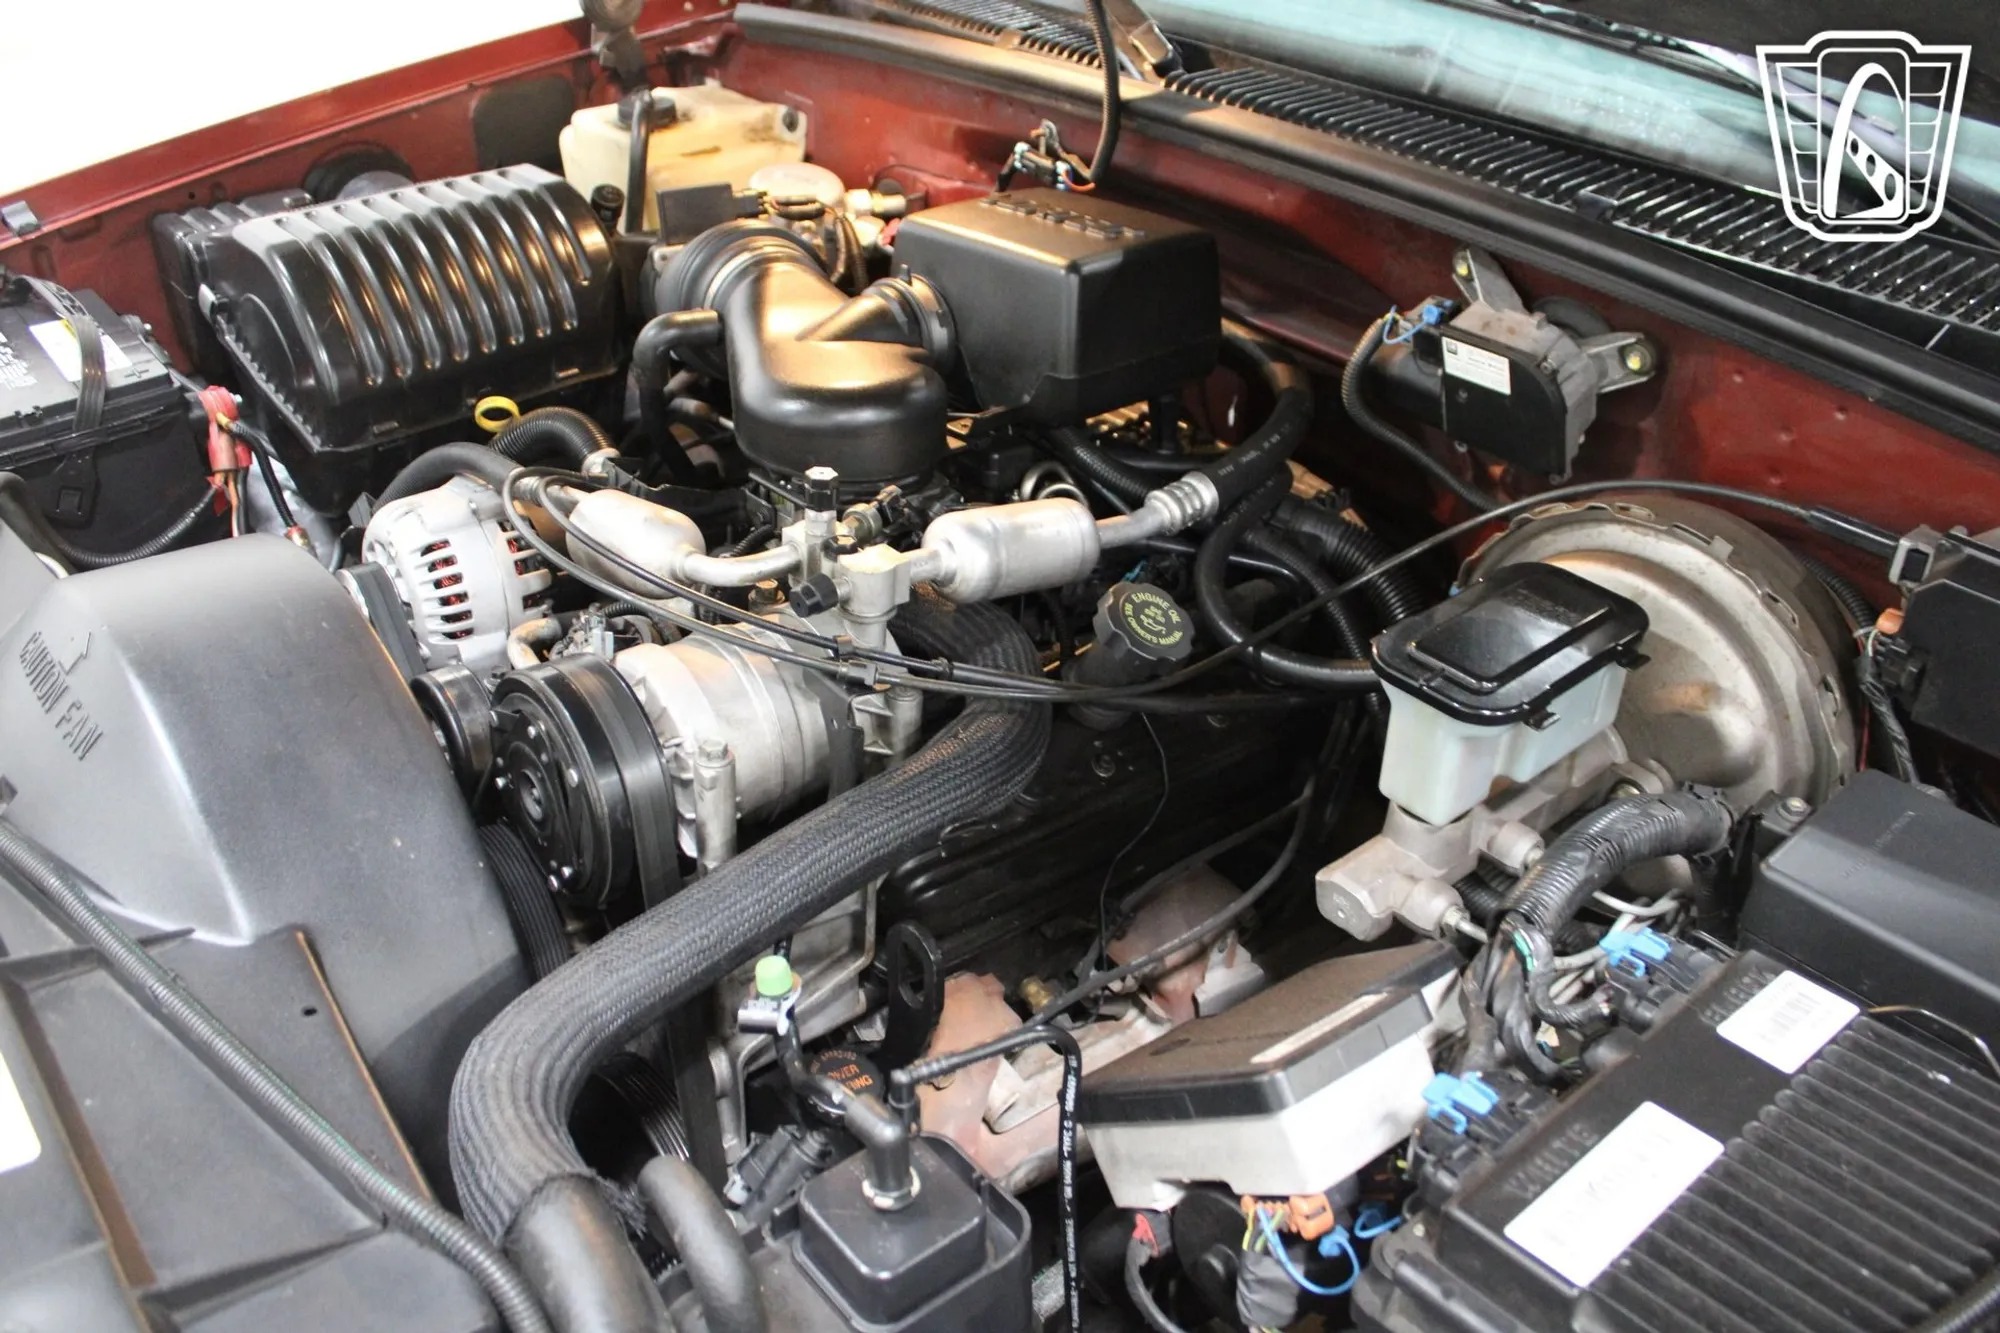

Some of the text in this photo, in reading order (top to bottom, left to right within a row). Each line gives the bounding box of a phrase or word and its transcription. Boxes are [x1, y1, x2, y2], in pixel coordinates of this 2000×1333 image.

[1131, 592, 1171, 611] ENGINE
[20, 631, 103, 761] CAUTION FAN
